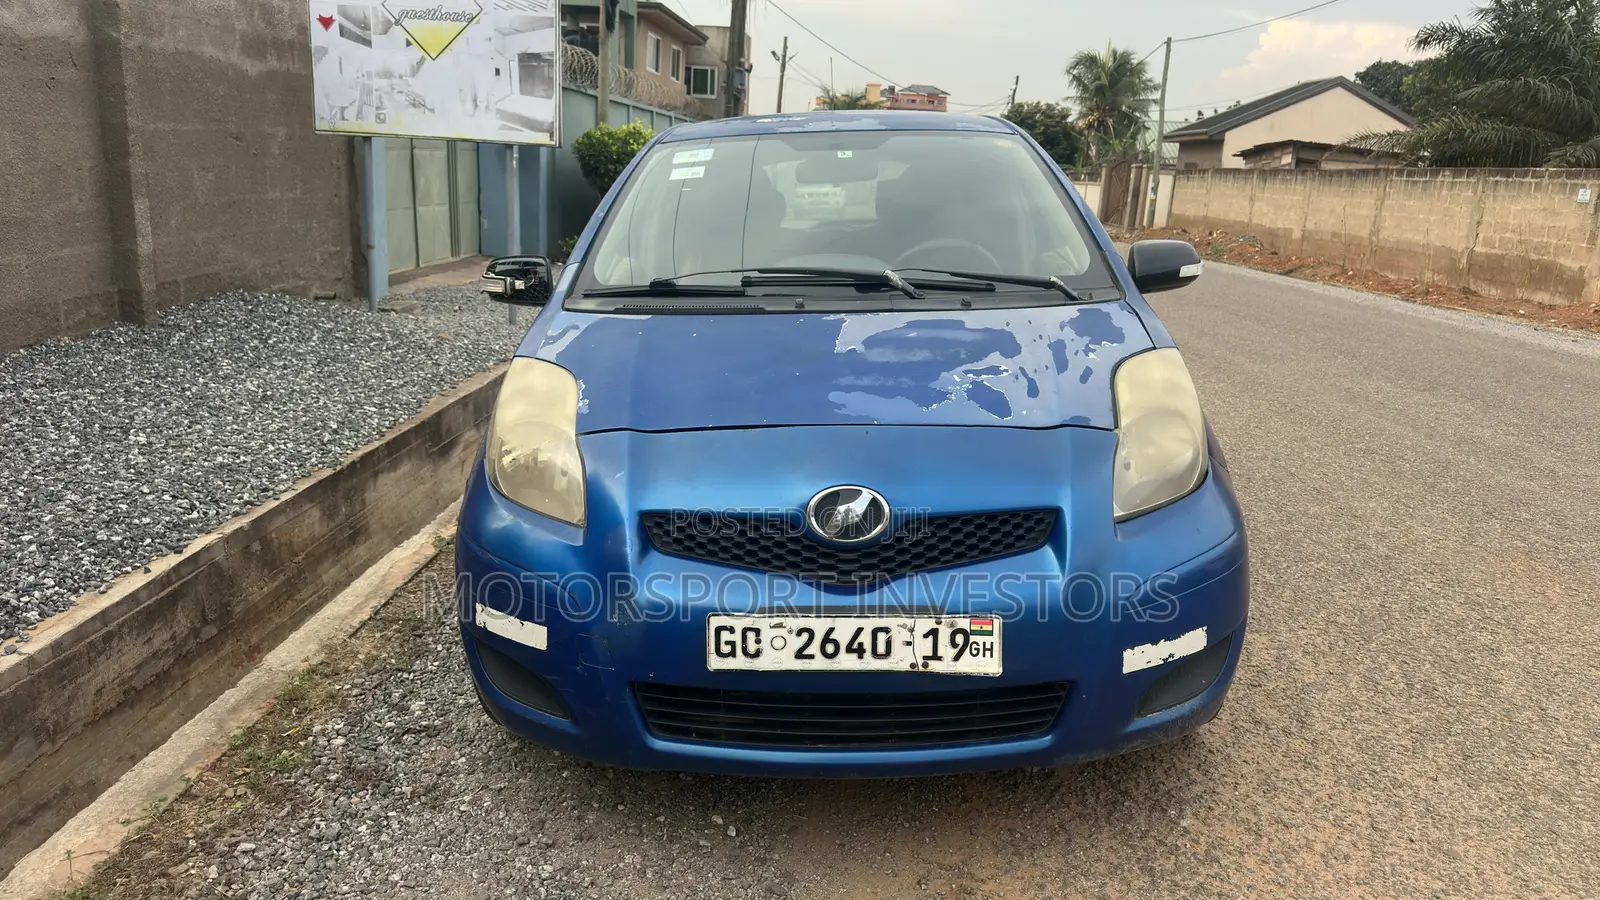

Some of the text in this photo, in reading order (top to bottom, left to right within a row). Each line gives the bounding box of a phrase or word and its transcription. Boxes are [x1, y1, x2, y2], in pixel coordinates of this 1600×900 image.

[394, 4, 475, 27] guesthouse
[714, 625, 762, 659] GC
[969, 640, 994, 659] GH
